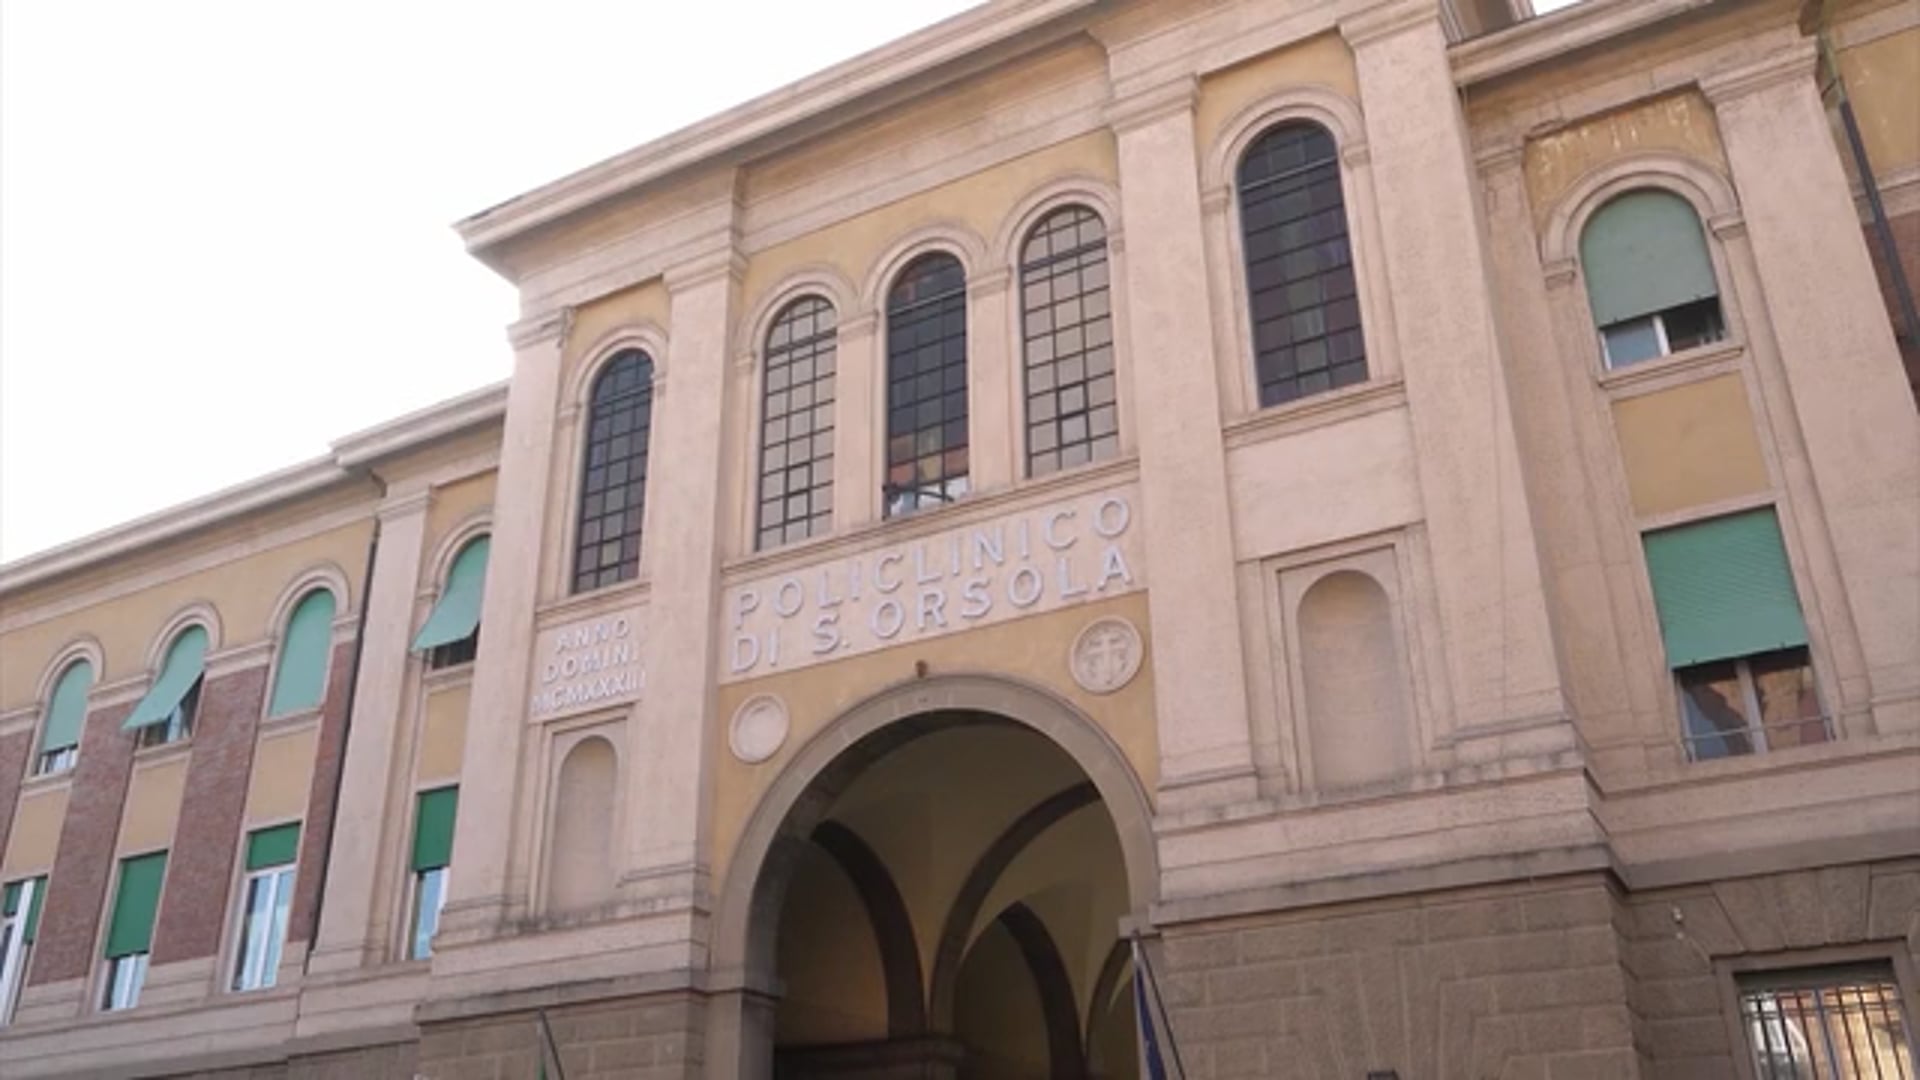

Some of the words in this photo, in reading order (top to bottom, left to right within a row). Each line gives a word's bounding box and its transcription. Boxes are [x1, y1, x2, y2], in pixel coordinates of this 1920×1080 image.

[735, 498, 1130, 630] POLICLINICO
[556, 617, 630, 653] ANNO
[731, 628, 778, 674] DI
[812, 613, 849, 655] S.
[871, 544, 1133, 639] ORSOLA
[542, 641, 639, 686] DOMINI
